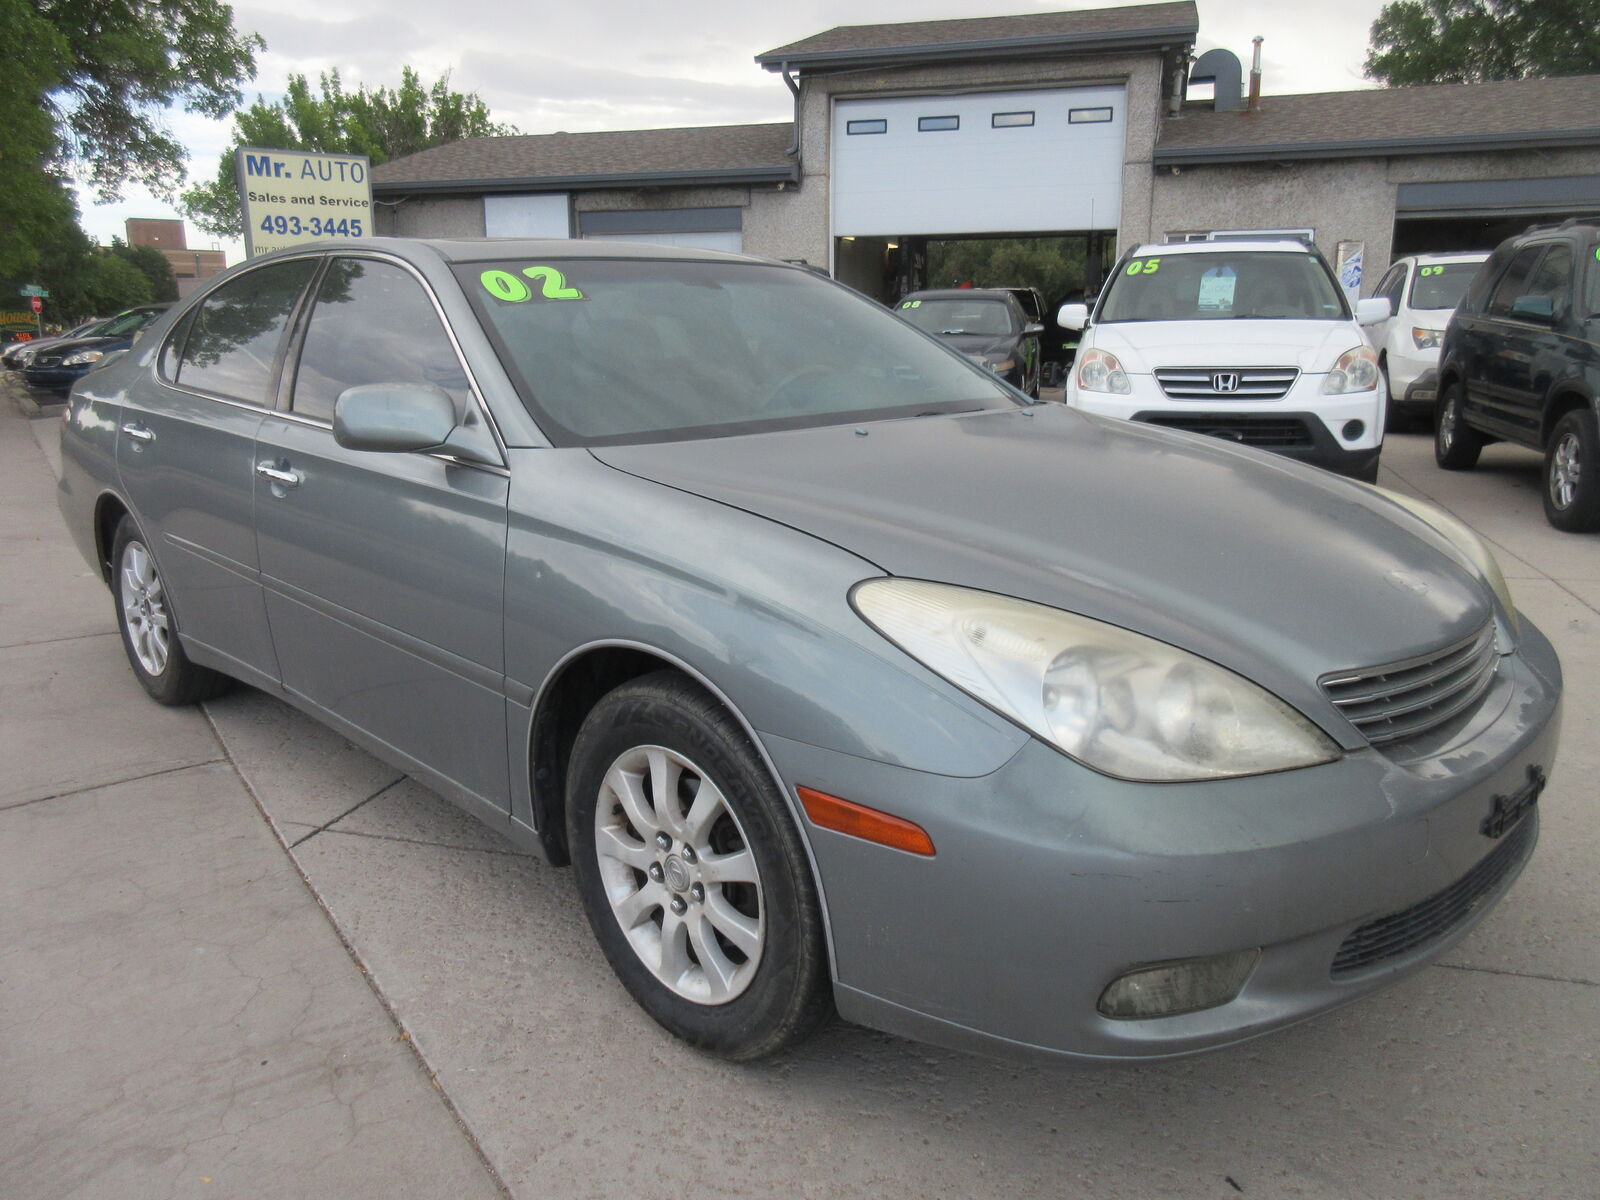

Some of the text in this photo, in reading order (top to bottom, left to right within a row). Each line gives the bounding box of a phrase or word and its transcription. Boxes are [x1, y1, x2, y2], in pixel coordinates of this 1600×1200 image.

[246, 155, 364, 183] Mr. AUTO
[248, 191, 369, 207] Sales and Service
[260, 215, 362, 237] 493-3445
[1126, 259, 1161, 275] 05
[1420, 265, 1444, 277] 09
[480, 266, 583, 302] 02
[902, 300, 922, 309] 08
